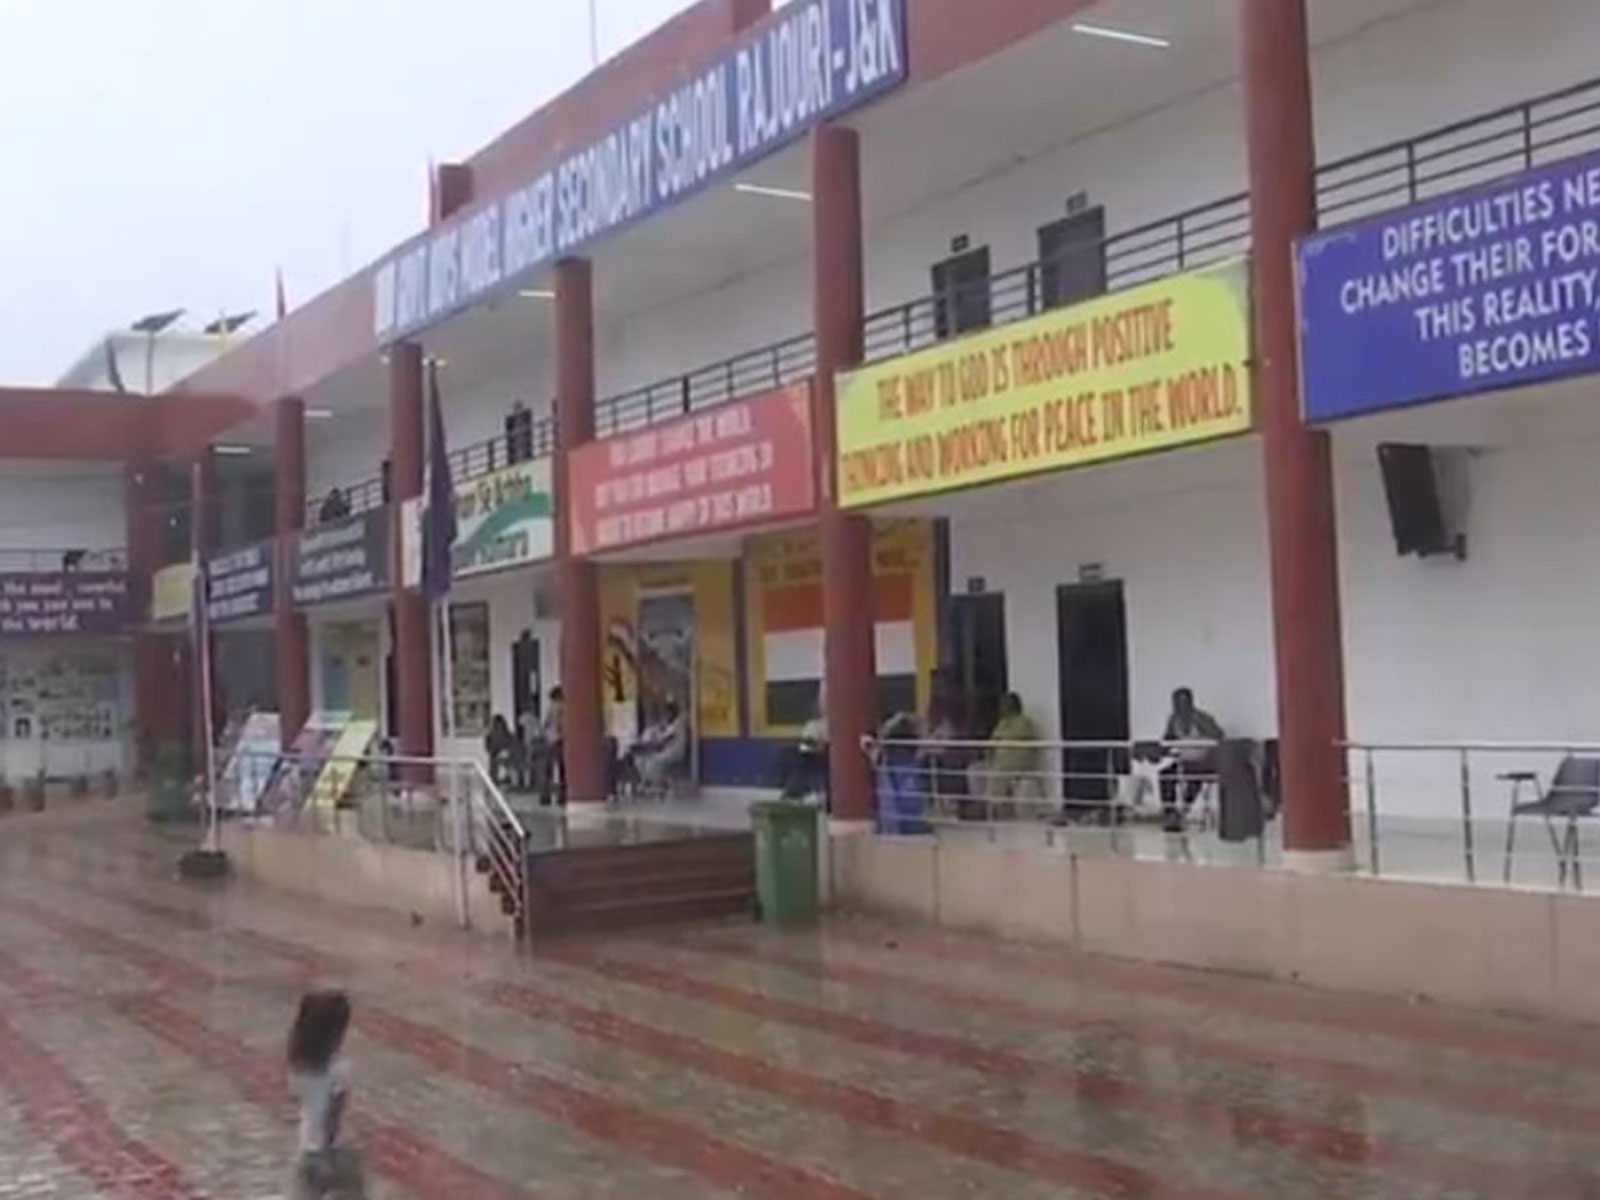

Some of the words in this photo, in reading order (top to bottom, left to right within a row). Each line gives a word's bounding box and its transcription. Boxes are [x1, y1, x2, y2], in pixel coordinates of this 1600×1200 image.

[558, 111, 652, 250] SECONDARY
[657, 62, 733, 198] SCHOOL
[1382, 181, 1554, 259] DIFFICULTIES
[1340, 258, 1446, 314] CHANGE
[1451, 242, 1533, 289] THEIR
[1414, 296, 1476, 341] THIS
[1484, 267, 1600, 328] REALITY,
[876, 374, 903, 420] THE
[906, 367, 935, 417] WAY
[938, 361, 956, 407] TO
[959, 351, 989, 402] GOD
[992, 345, 1009, 393] IS
[1012, 322, 1088, 390] THROUGH
[1091, 298, 1174, 369] POSITIVE
[1459, 320, 1591, 379] BECOMES
[906, 433, 934, 480] AND
[937, 416, 1009, 475] WORKING
[1011, 407, 1040, 462] FOR
[1044, 391, 1098, 454] PEACE
[1101, 389, 1124, 442] IN
[1127, 379, 1164, 439] THE
[1166, 362, 1242, 430] WORLD.
